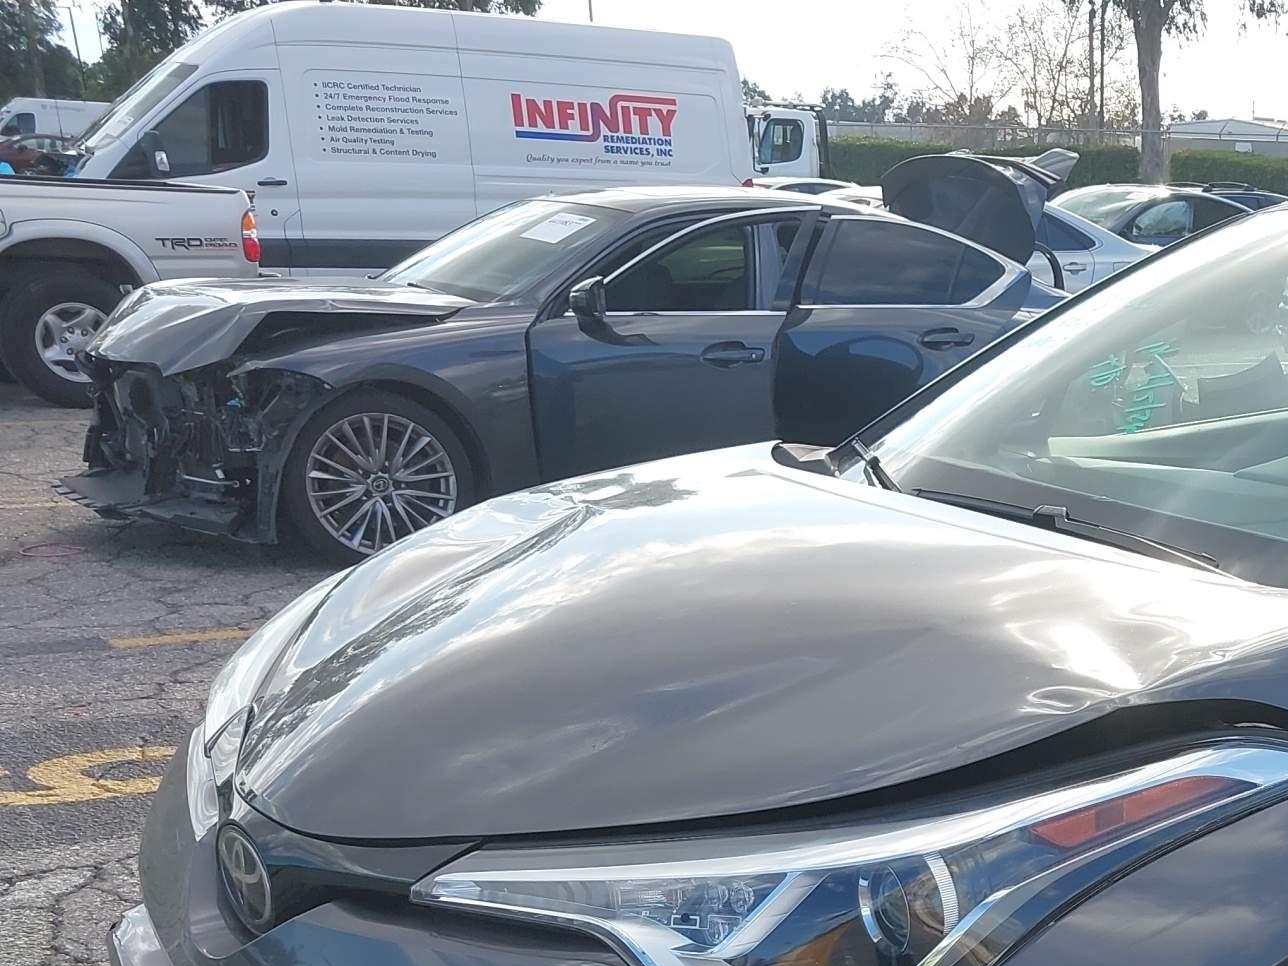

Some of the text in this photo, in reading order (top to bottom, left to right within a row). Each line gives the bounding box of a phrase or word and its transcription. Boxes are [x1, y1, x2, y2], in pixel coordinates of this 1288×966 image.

[381, 84, 422, 93] Technician
[342, 93, 386, 103] Emergency
[411, 96, 450, 105] Response
[325, 103, 458, 116] Complete Reconstruction Services
[326, 114, 419, 125] Leak Detection Services
[511, 93, 677, 142] INFINITY
[328, 125, 348, 133] Mold
[349, 126, 398, 135] Remediation
[406, 128, 434, 138] Testing
[342, 136, 369, 145] Quality
[369, 137, 395, 147] Testing
[603, 134, 672, 147] REMEDIATION
[330, 146, 437, 159] Structural & Content Drying
[526, 152, 555, 164] Quality
[604, 145, 655, 158] SERVICES,
[155, 237, 203, 251] TRD
